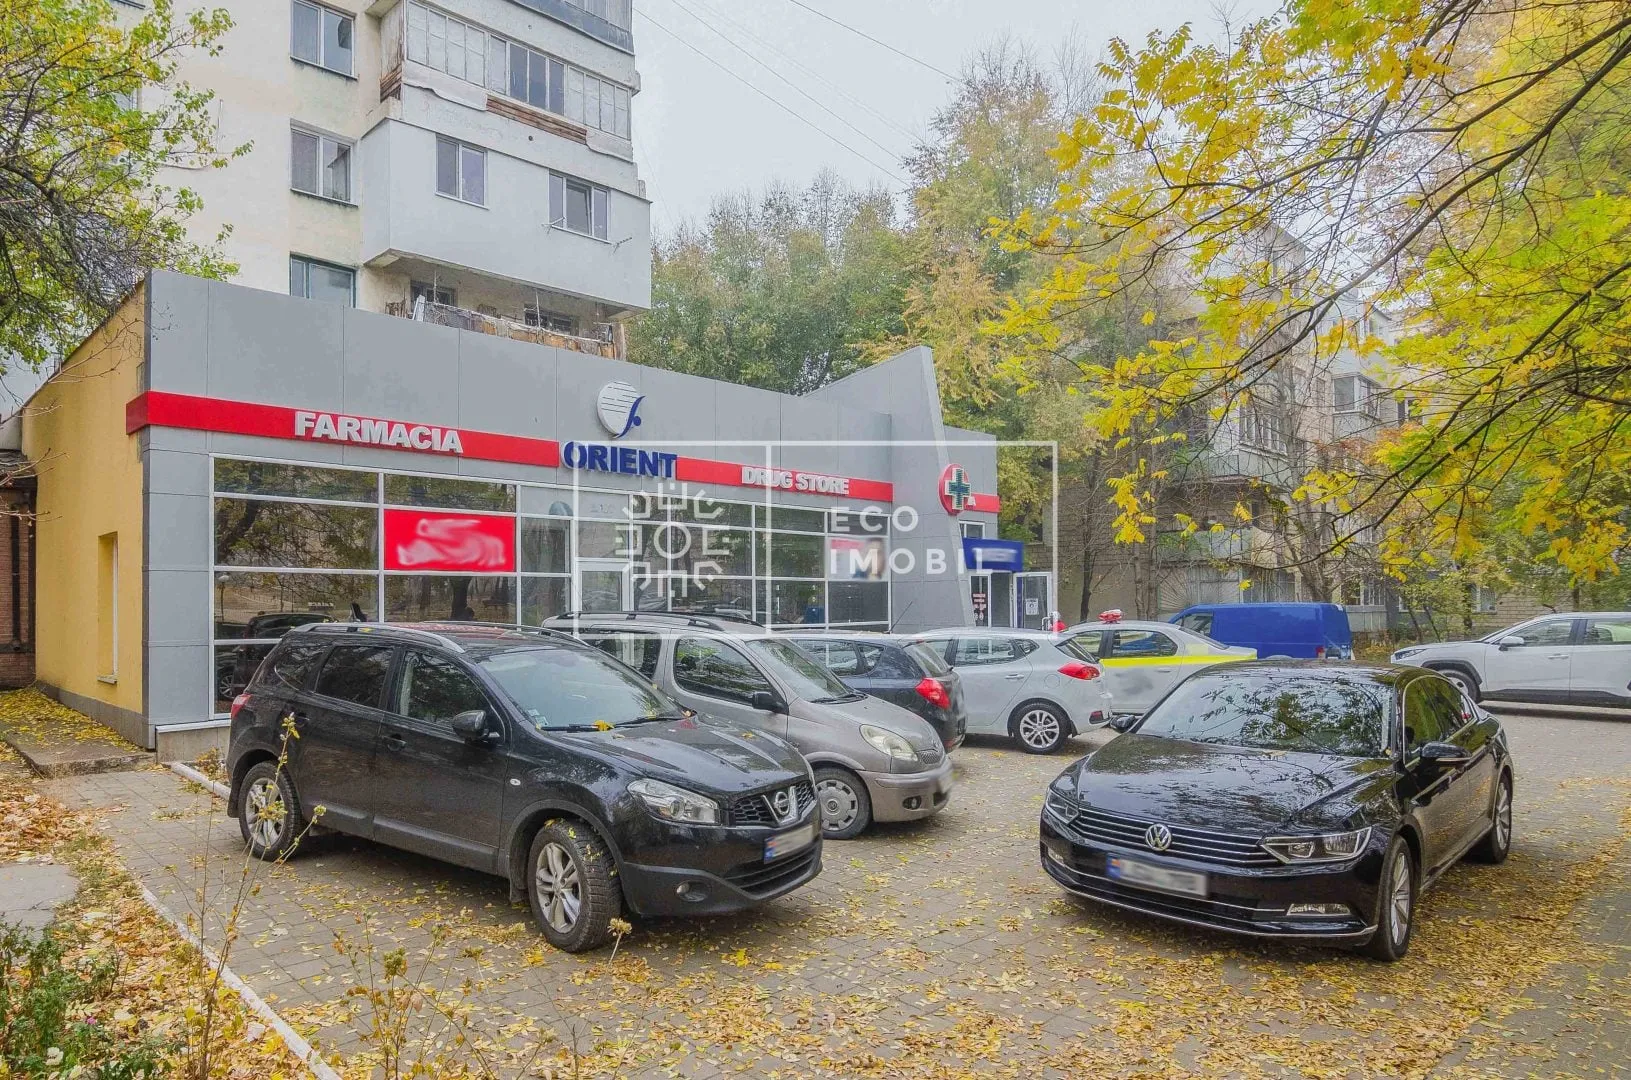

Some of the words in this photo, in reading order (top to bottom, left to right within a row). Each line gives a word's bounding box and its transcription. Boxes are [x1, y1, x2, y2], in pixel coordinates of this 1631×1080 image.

[295, 411, 463, 453] FARMACIA
[562, 441, 678, 479] ORIENT
[741, 466, 793, 489] DRUG
[795, 473, 850, 495] STORE
